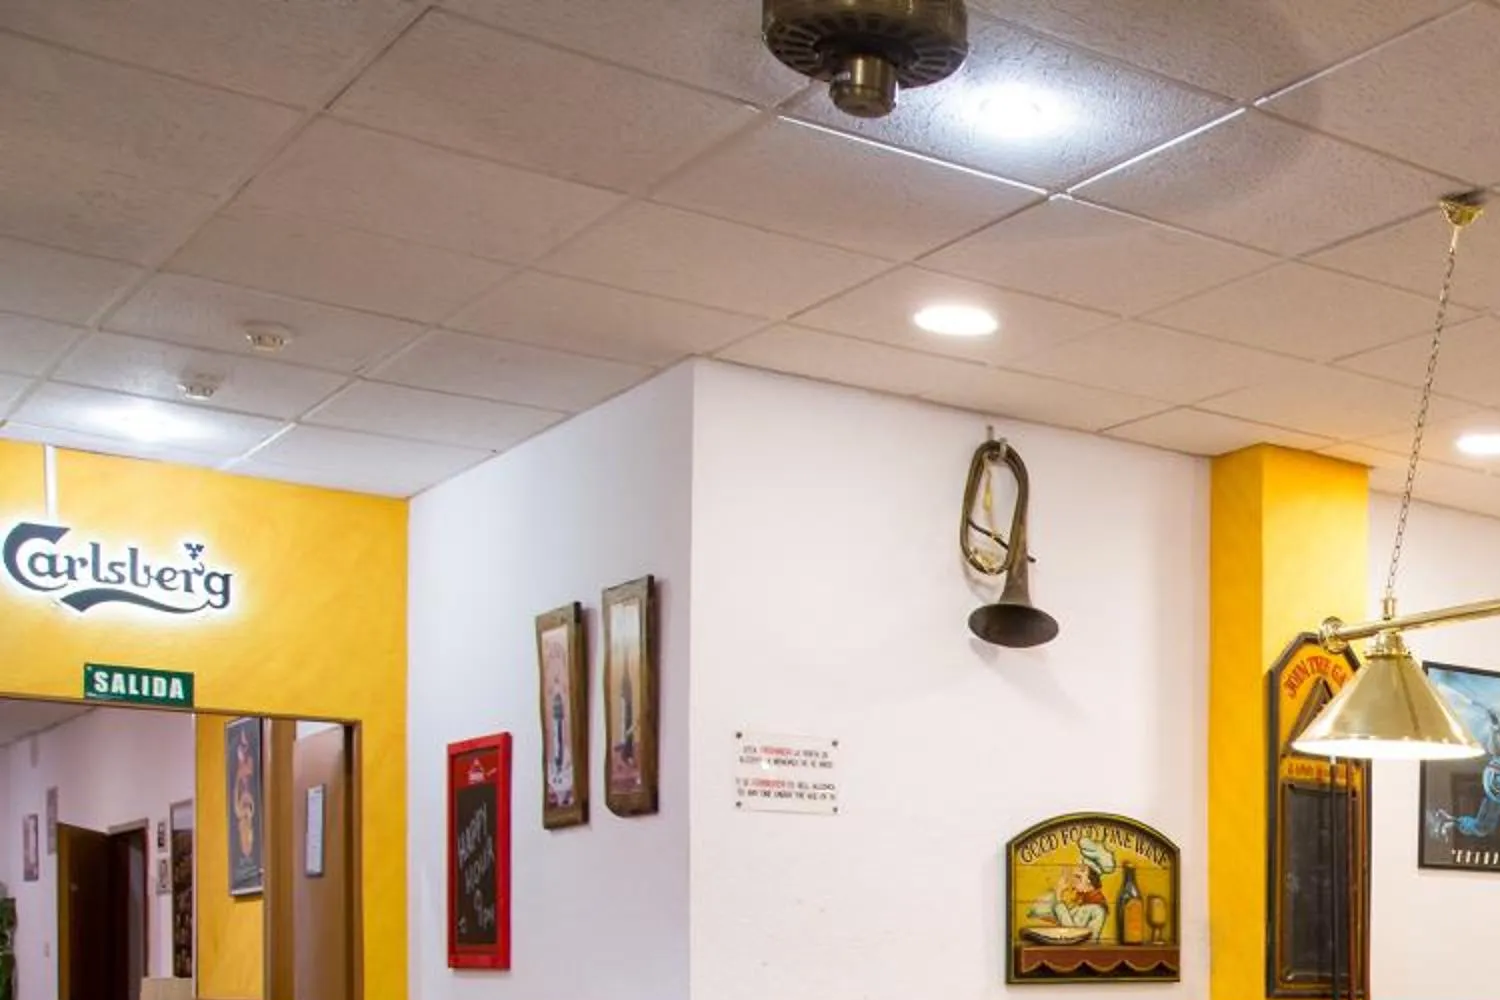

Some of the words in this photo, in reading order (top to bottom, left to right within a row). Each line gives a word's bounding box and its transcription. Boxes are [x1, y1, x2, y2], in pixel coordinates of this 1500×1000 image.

[3, 522, 233, 610] Carlsberg
[93, 671, 184, 699] SALIDA
[1019, 832, 1059, 864] GOOD
